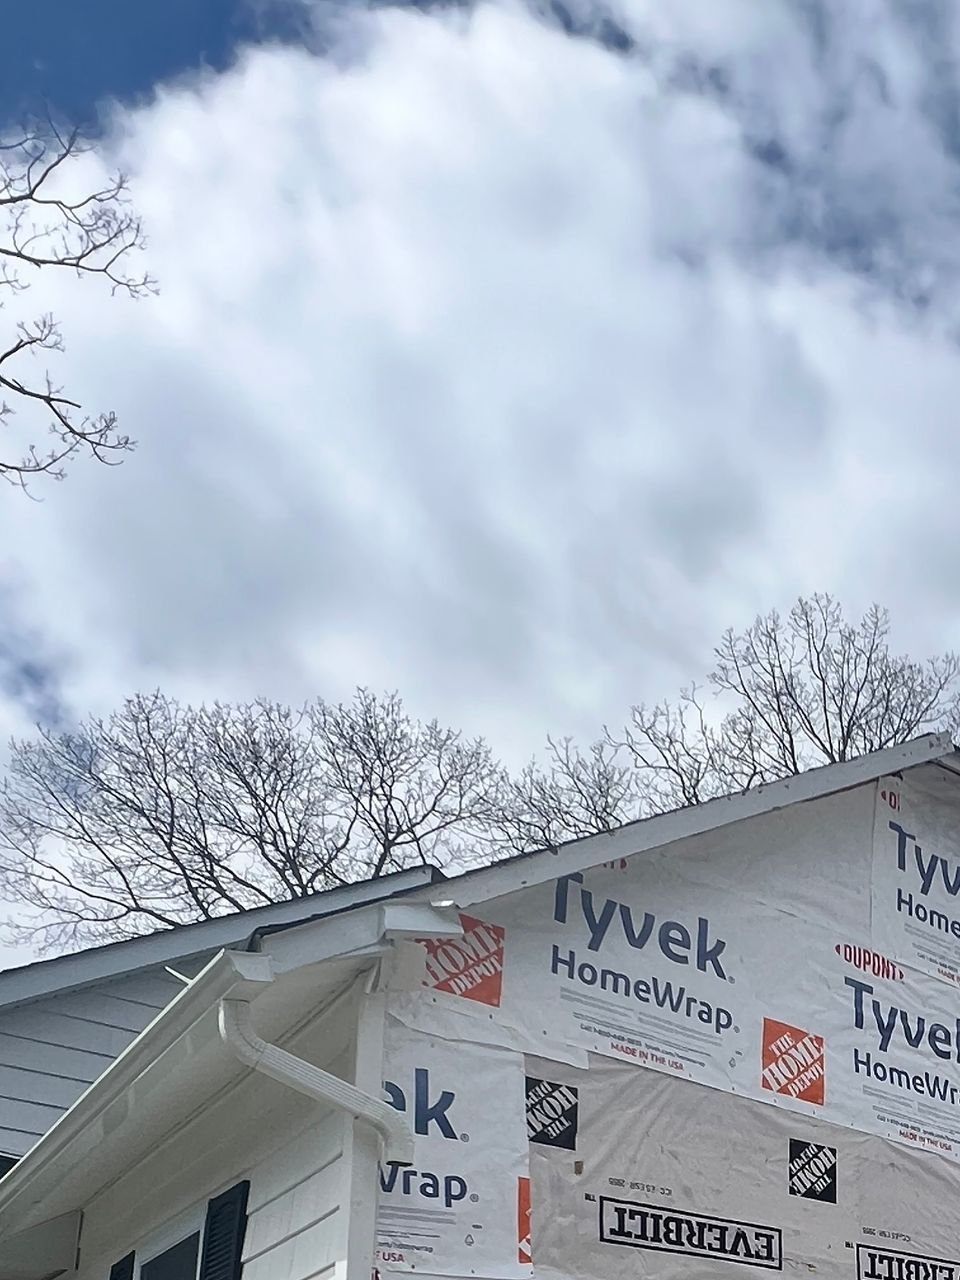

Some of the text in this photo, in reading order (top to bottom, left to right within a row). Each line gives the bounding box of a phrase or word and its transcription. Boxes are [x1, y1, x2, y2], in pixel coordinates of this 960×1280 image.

[553, 873, 727, 980] Tyvek
[843, 943, 897, 981] DUPONT
[551, 944, 733, 1034] HomeWrap
[610, 1042, 684, 1070] MADE IN THE USA
[763, 1033, 824, 1092] HOME
[788, 1062, 824, 1097] DEPOT
[790, 1144, 818, 1173] DEPOT
[790, 1147, 836, 1196] HOME
[609, 1206, 775, 1262] EVERBILT
[382, 1252, 404, 1262] USA
